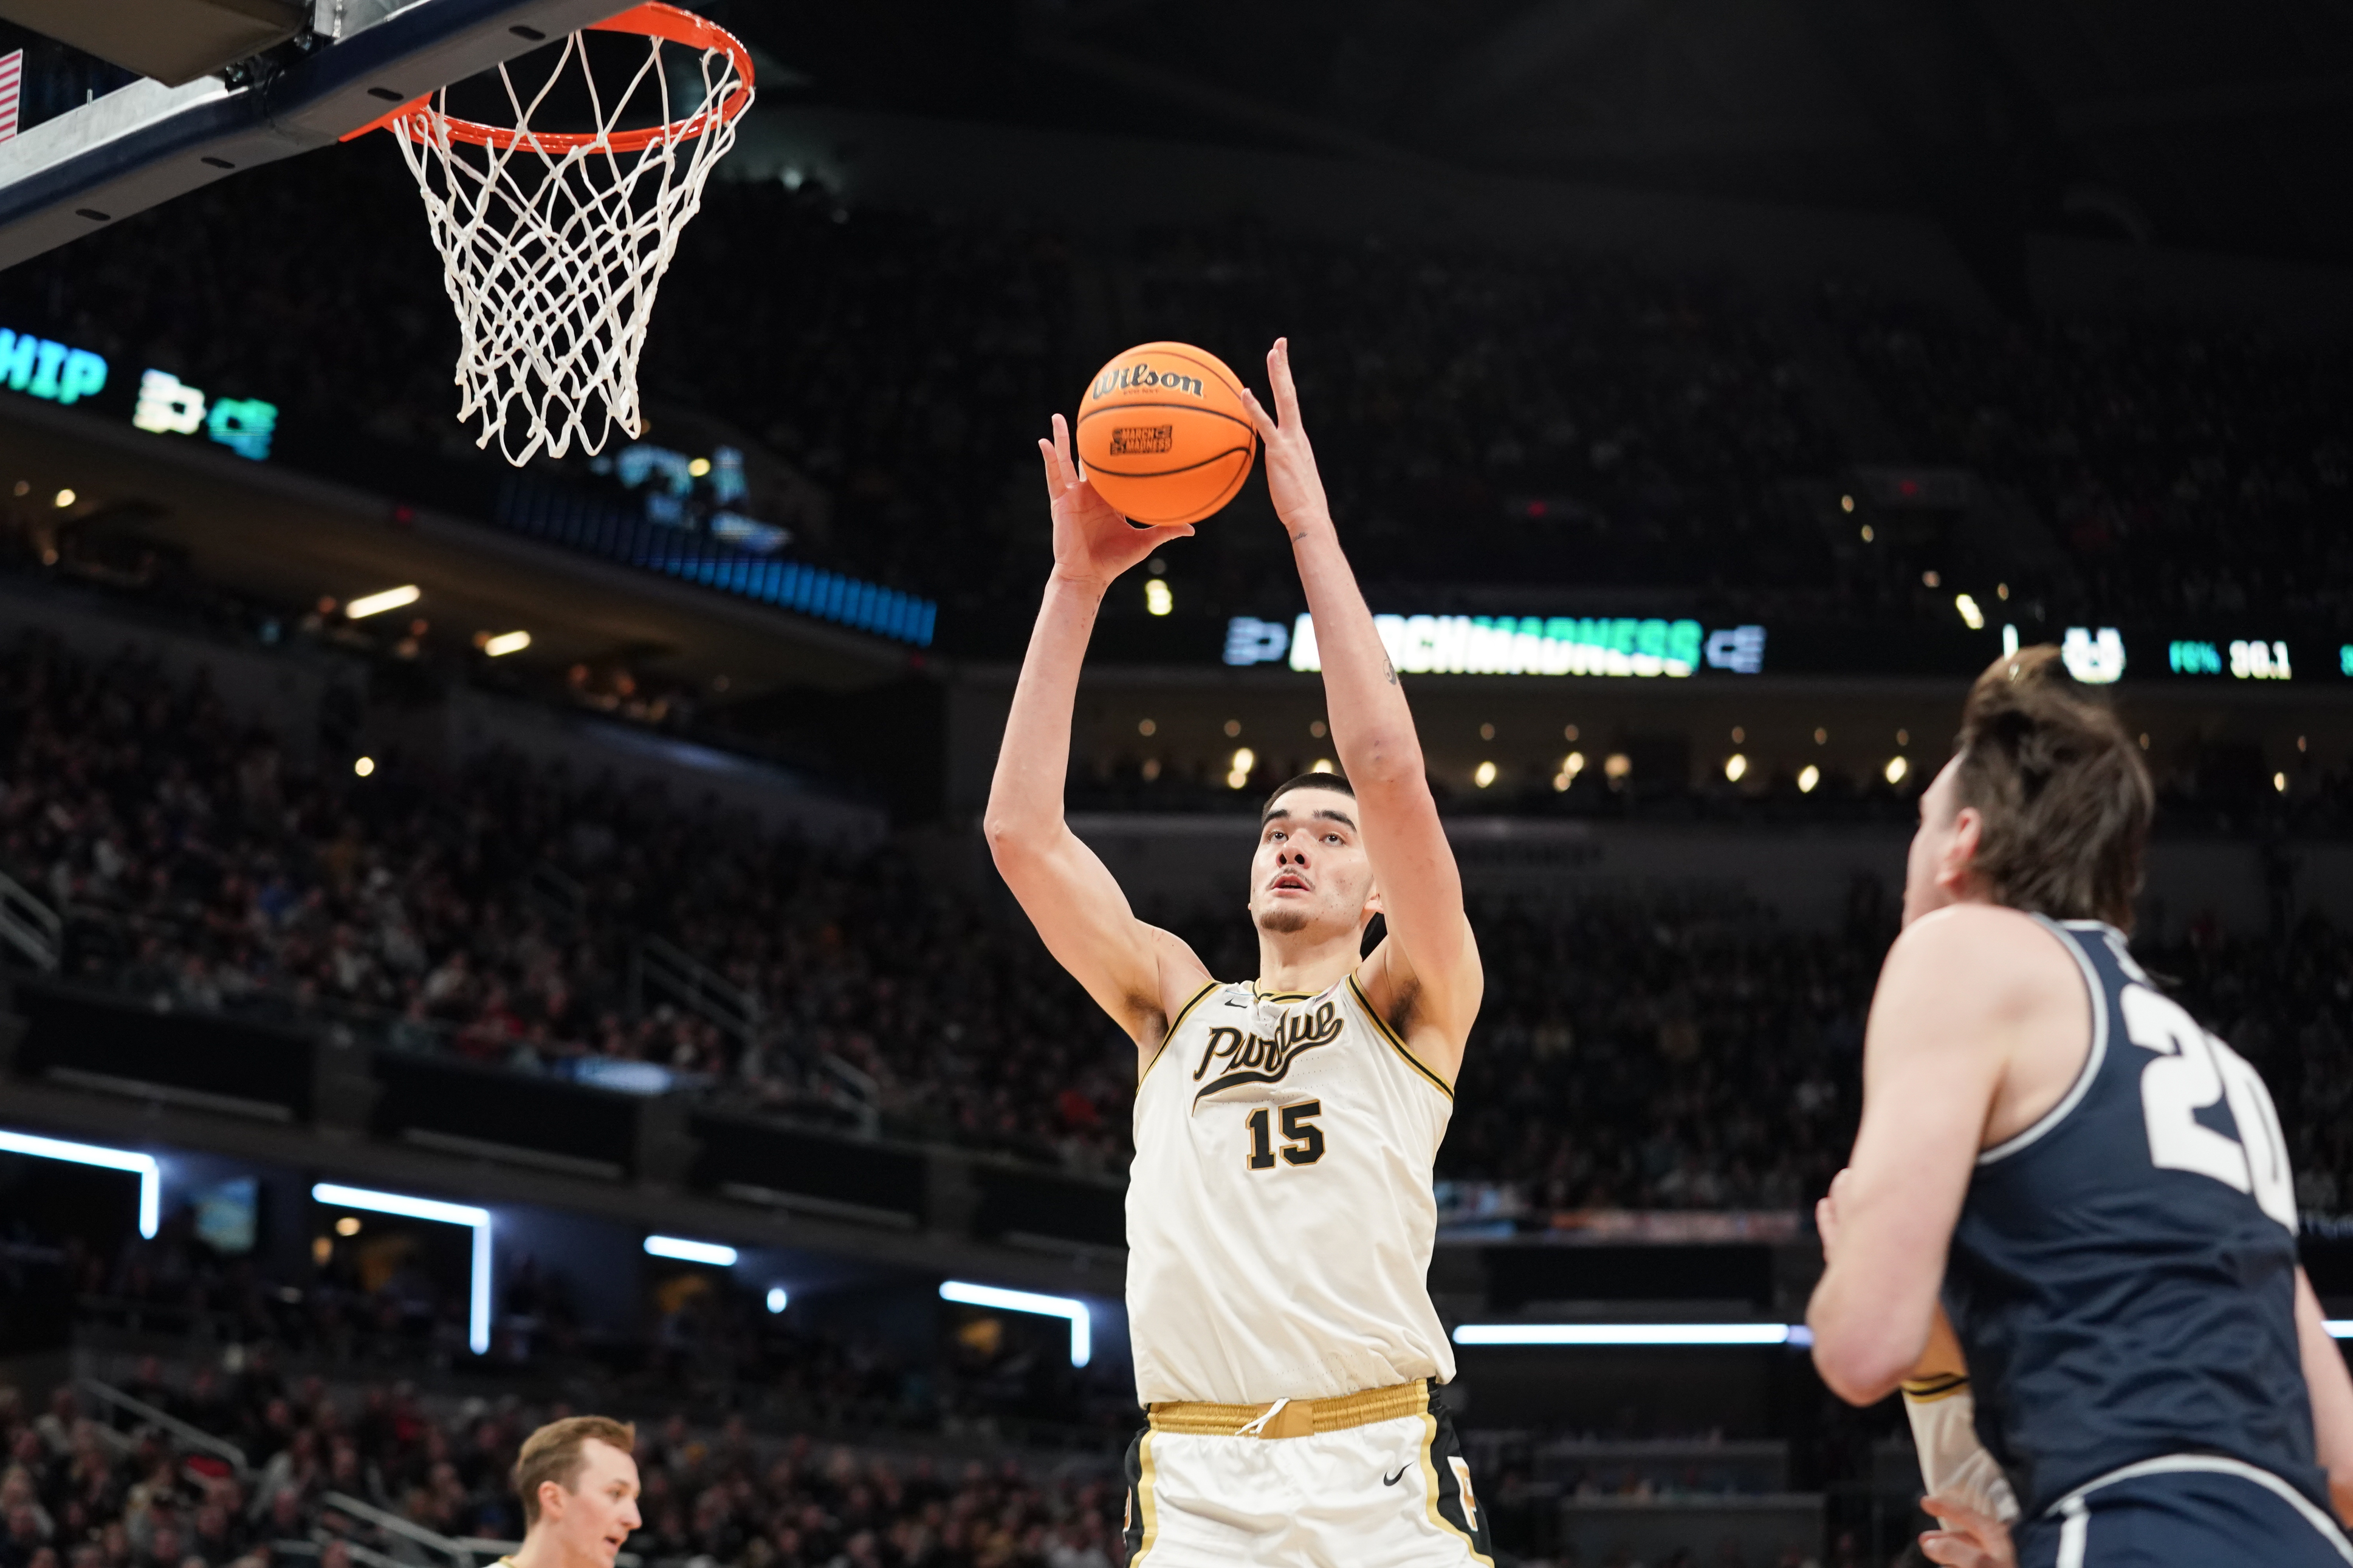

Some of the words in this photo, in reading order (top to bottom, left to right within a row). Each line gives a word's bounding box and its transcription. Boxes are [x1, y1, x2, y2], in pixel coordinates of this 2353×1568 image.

[0, 327, 108, 405] HIP
[1093, 363, 1204, 400] Wilson
[1122, 428, 1155, 439] MARCH
[1125, 439, 1172, 453] MADNESS
[1192, 1001, 1344, 1097] Purdue
[1245, 1099, 1326, 1171] 15
[2120, 983, 2298, 1236] 20
